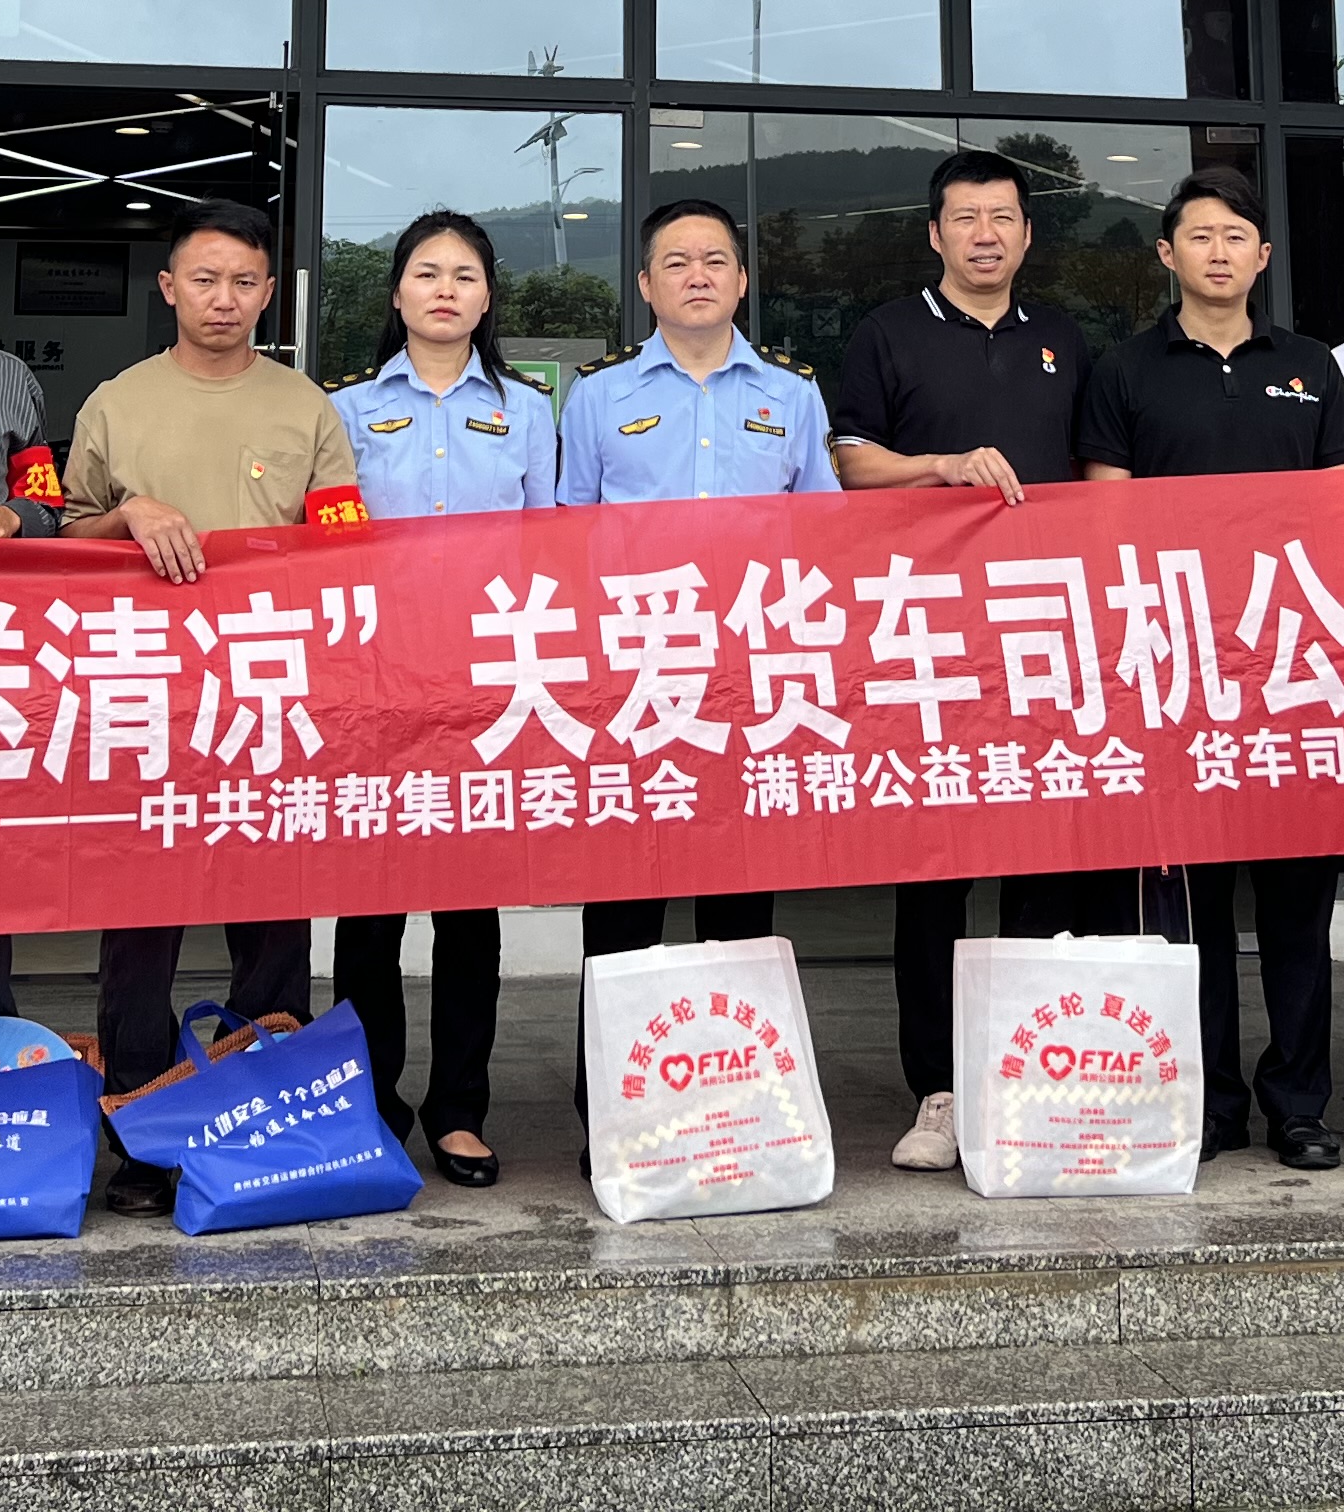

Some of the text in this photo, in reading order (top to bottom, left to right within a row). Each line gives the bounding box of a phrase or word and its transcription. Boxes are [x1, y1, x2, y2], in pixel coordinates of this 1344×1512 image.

[741, 735, 1145, 816] 满帮公益基金会
[621, 991, 796, 1100] 情系车轮 夏送清凉
[698, 1045, 757, 1075] FTAF
[999, 991, 1179, 1085] 情系车轮 夏送清凉
[1079, 1050, 1144, 1072] FTAF
